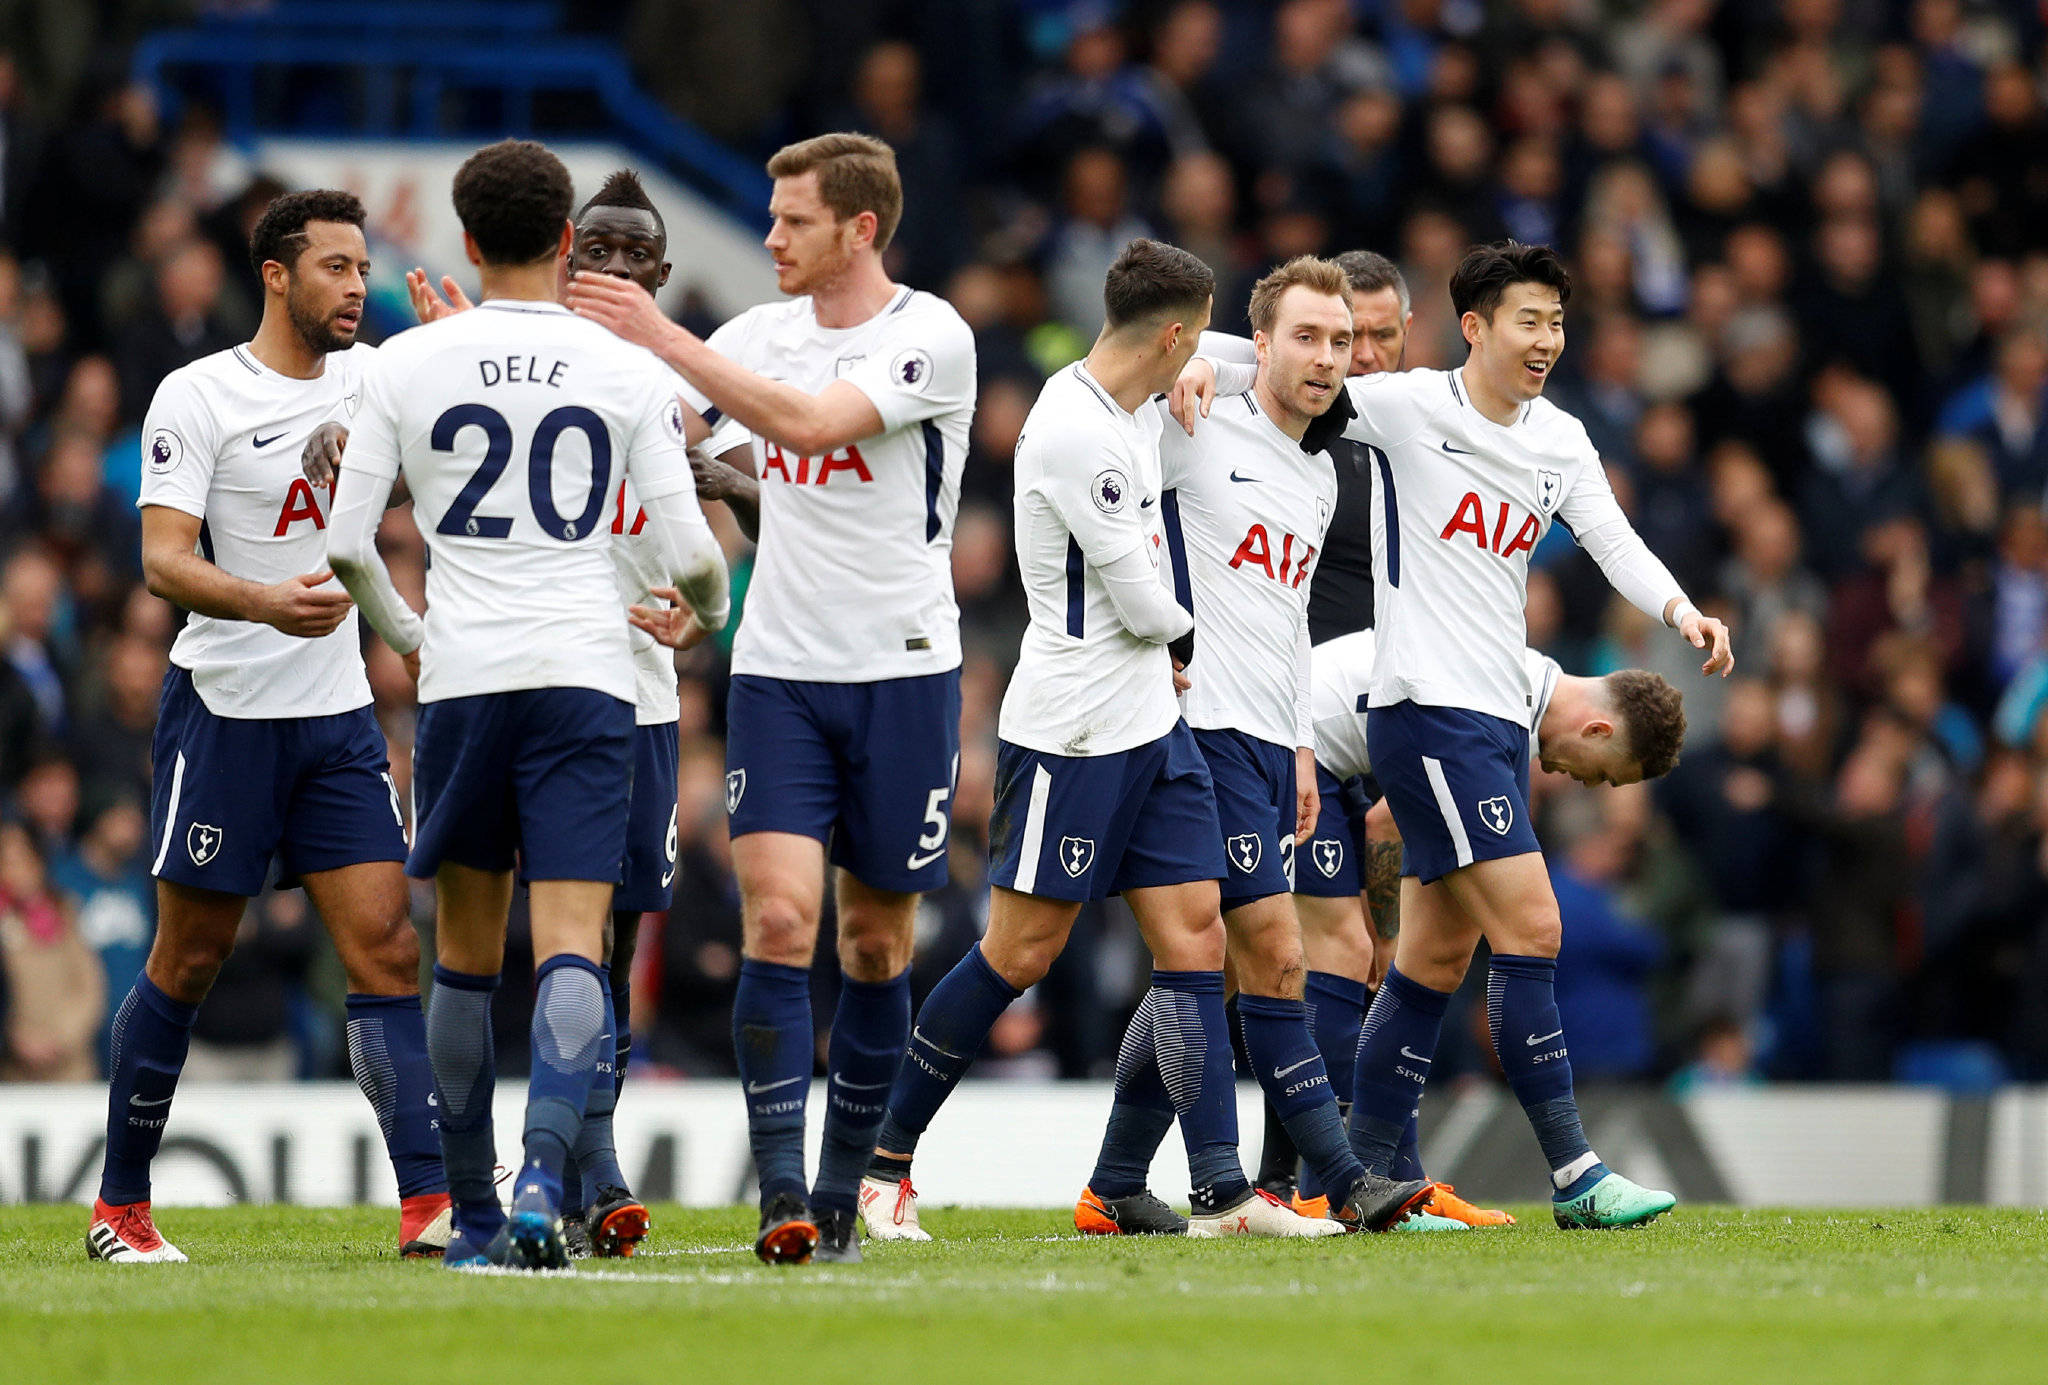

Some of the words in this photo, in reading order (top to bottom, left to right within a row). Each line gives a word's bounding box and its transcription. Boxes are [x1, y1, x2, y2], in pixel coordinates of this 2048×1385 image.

[479, 356, 570, 388] DELE
[431, 403, 612, 542] 20
[917, 786, 950, 851] 5
[907, 1047, 949, 1082] SPURS
[1285, 1074, 1329, 1097] SPURS
